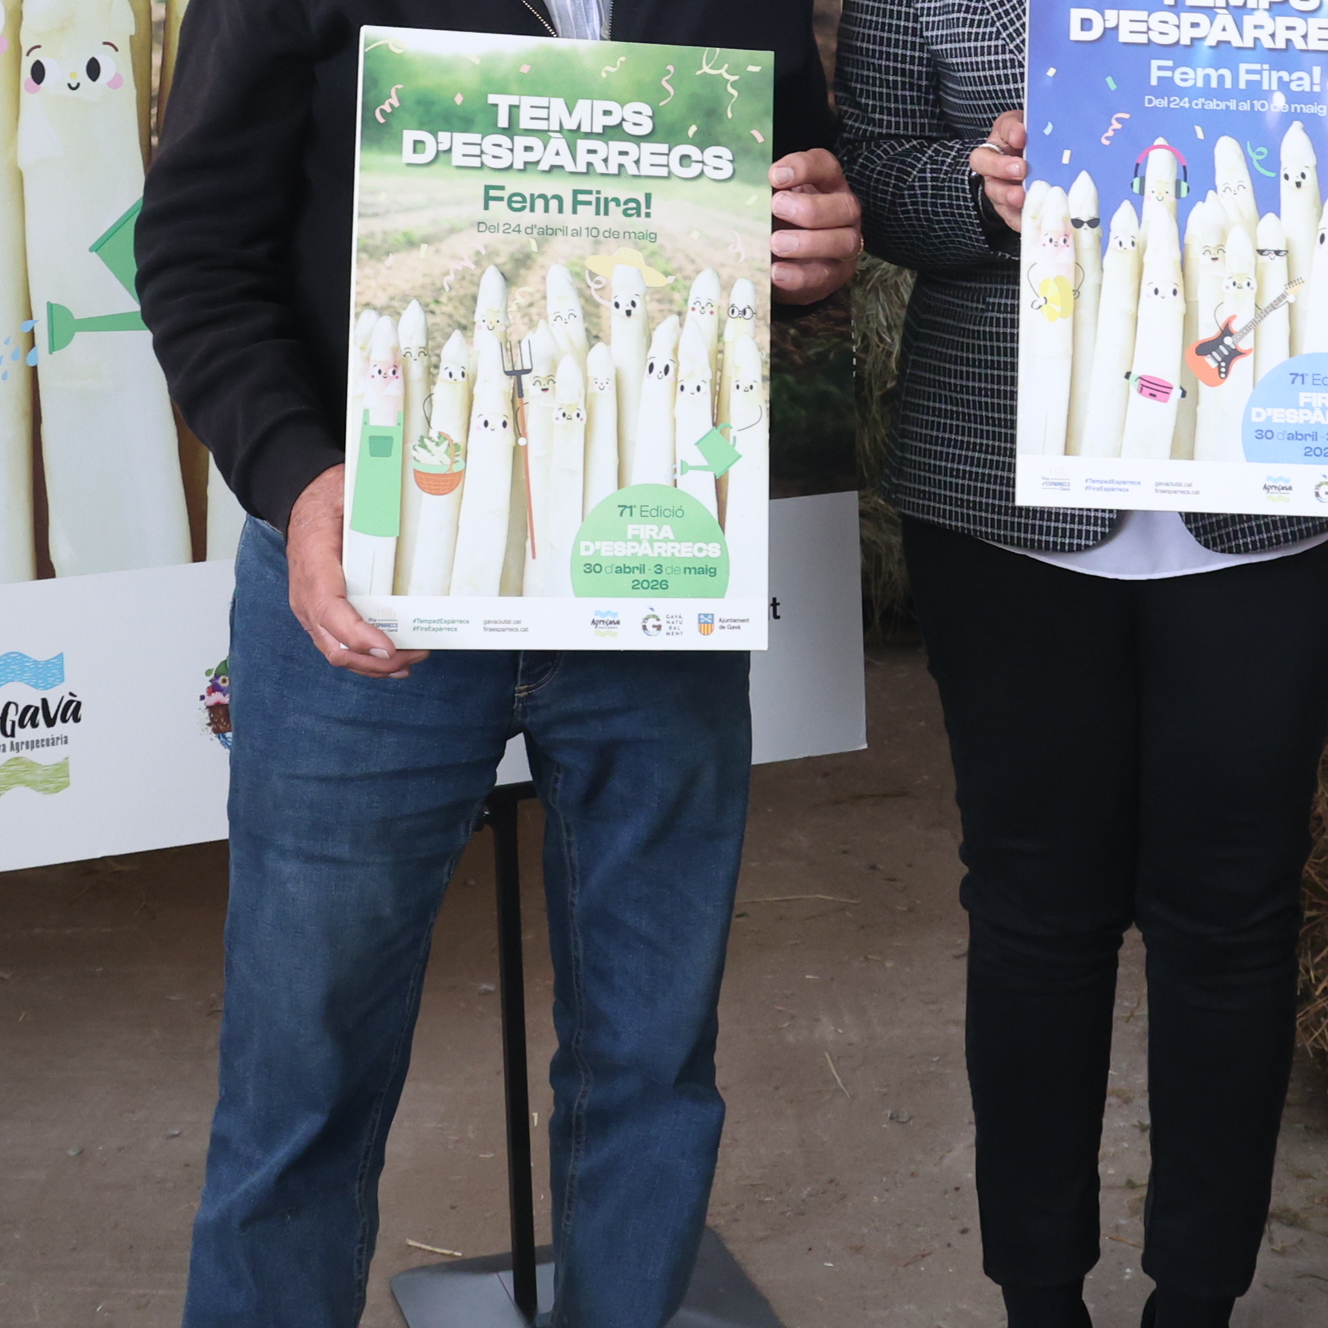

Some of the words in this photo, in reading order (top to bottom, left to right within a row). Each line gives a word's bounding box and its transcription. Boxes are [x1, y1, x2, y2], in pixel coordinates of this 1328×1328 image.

[1150, 59, 1232, 89] Fem
[1238, 62, 1321, 92] Fira!
[487, 93, 654, 136] TEMPS
[1144, 95, 1168, 108] Del
[1169, 96, 1190, 109] 24
[1238, 99, 1250, 111] al
[1252, 100, 1269, 112] 10
[1271, 100, 1289, 113] de
[1291, 102, 1327, 116] maig
[483, 184, 564, 214] Fem
[572, 188, 652, 218] Fira!
[477, 222, 499, 233] Del
[502, 223, 521, 235] 24
[571, 226, 582, 237] al
[586, 227, 600, 238] 10
[602, 227, 620, 239] de
[623, 229, 658, 243] maig
[1254, 429, 1274, 441] 30
[640, 504, 685, 518] Edició
[627, 524, 675, 540] FIRA
[583, 563, 603, 574] 30
[653, 564, 663, 575] 3
[665, 564, 682, 575] de
[683, 564, 717, 578] maig
[631, 579, 669, 590] 2026
[10, 733, 69, 754] Agropecuària
